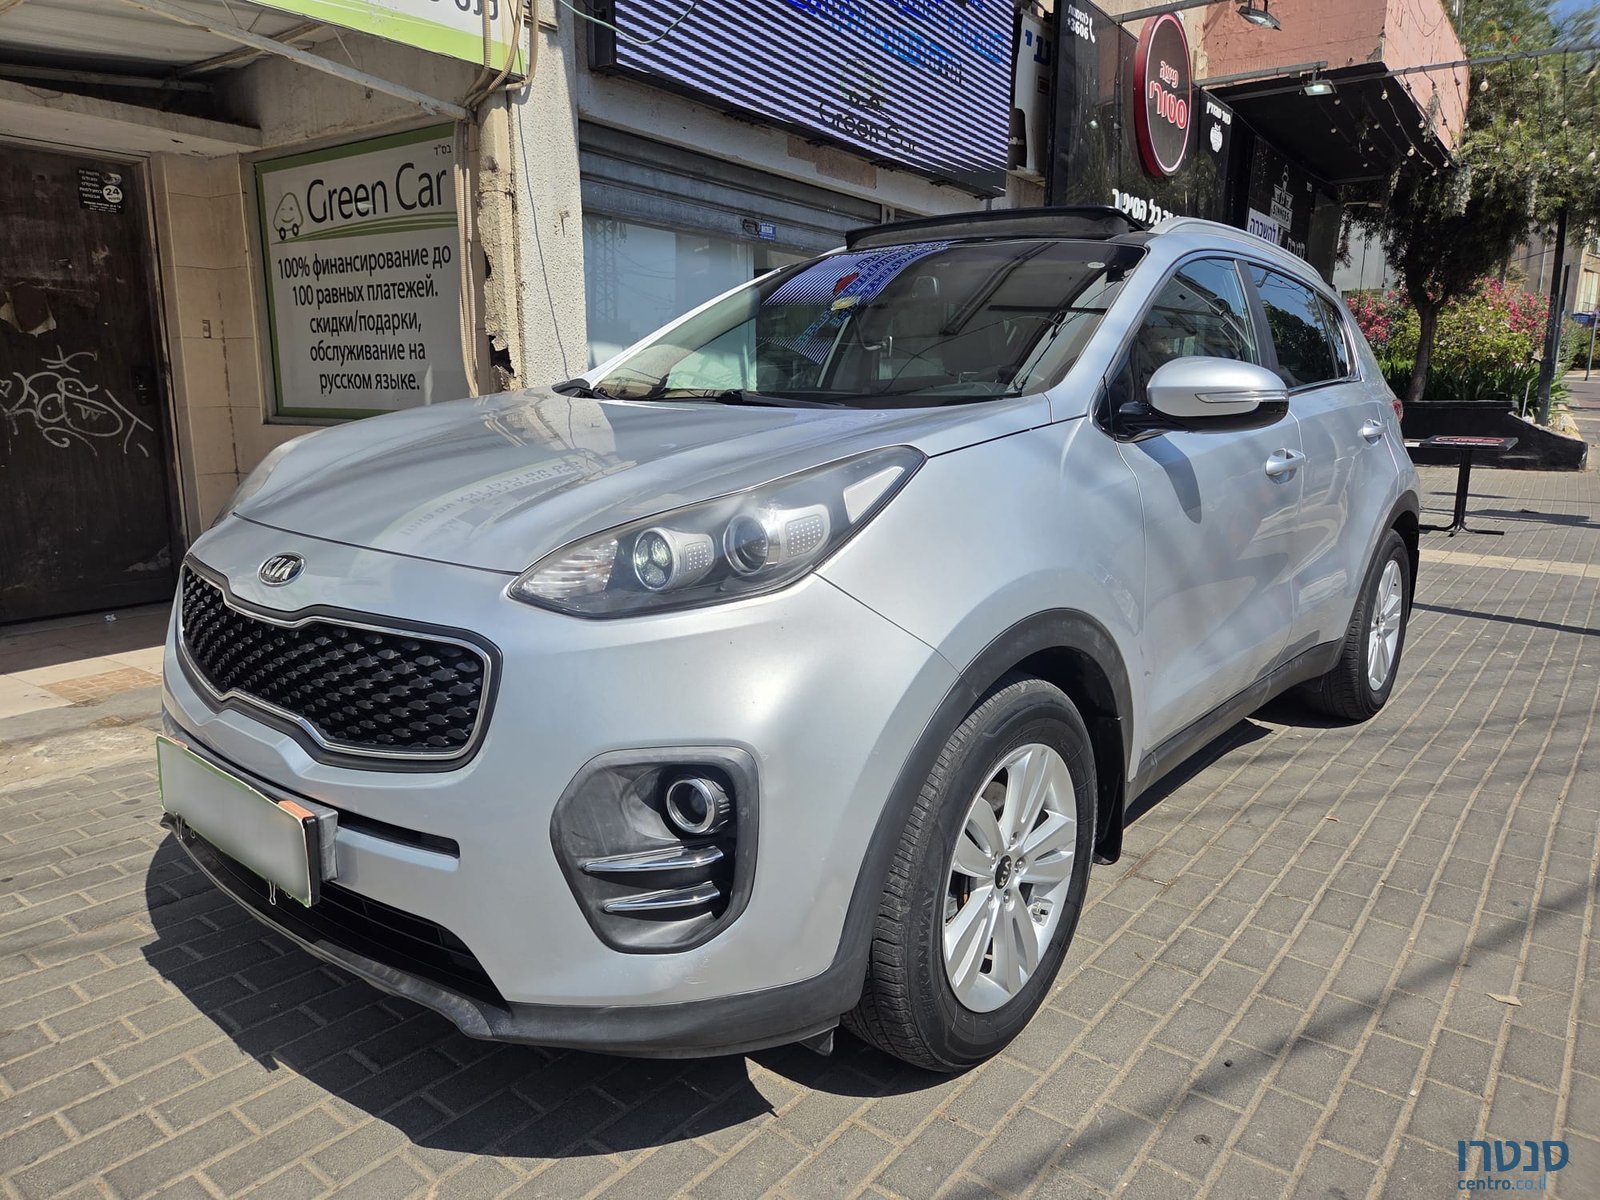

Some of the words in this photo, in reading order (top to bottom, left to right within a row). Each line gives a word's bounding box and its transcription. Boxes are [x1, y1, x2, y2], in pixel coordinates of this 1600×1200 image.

[1149, 80, 1188, 130] סטורי
[105, 187, 120, 196] 24
[306, 178, 389, 224] Green
[395, 162, 447, 211] Car
[1112, 188, 1147, 222] הסיפור
[1249, 218, 1276, 243] להשכרה
[278, 255, 310, 280] 100%
[312, 247, 429, 277] финансирование
[432, 244, 452, 269] до
[292, 284, 314, 306] 100
[316, 283, 365, 310] равных
[367, 273, 438, 301] платежей.
[309, 310, 422, 336] скидки/подарки,
[309, 340, 405, 367] обслуживание
[409, 342, 426, 361] на
[319, 371, 373, 395] русском
[375, 371, 420, 391] языке.
[998, 860, 1011, 886] KIA
